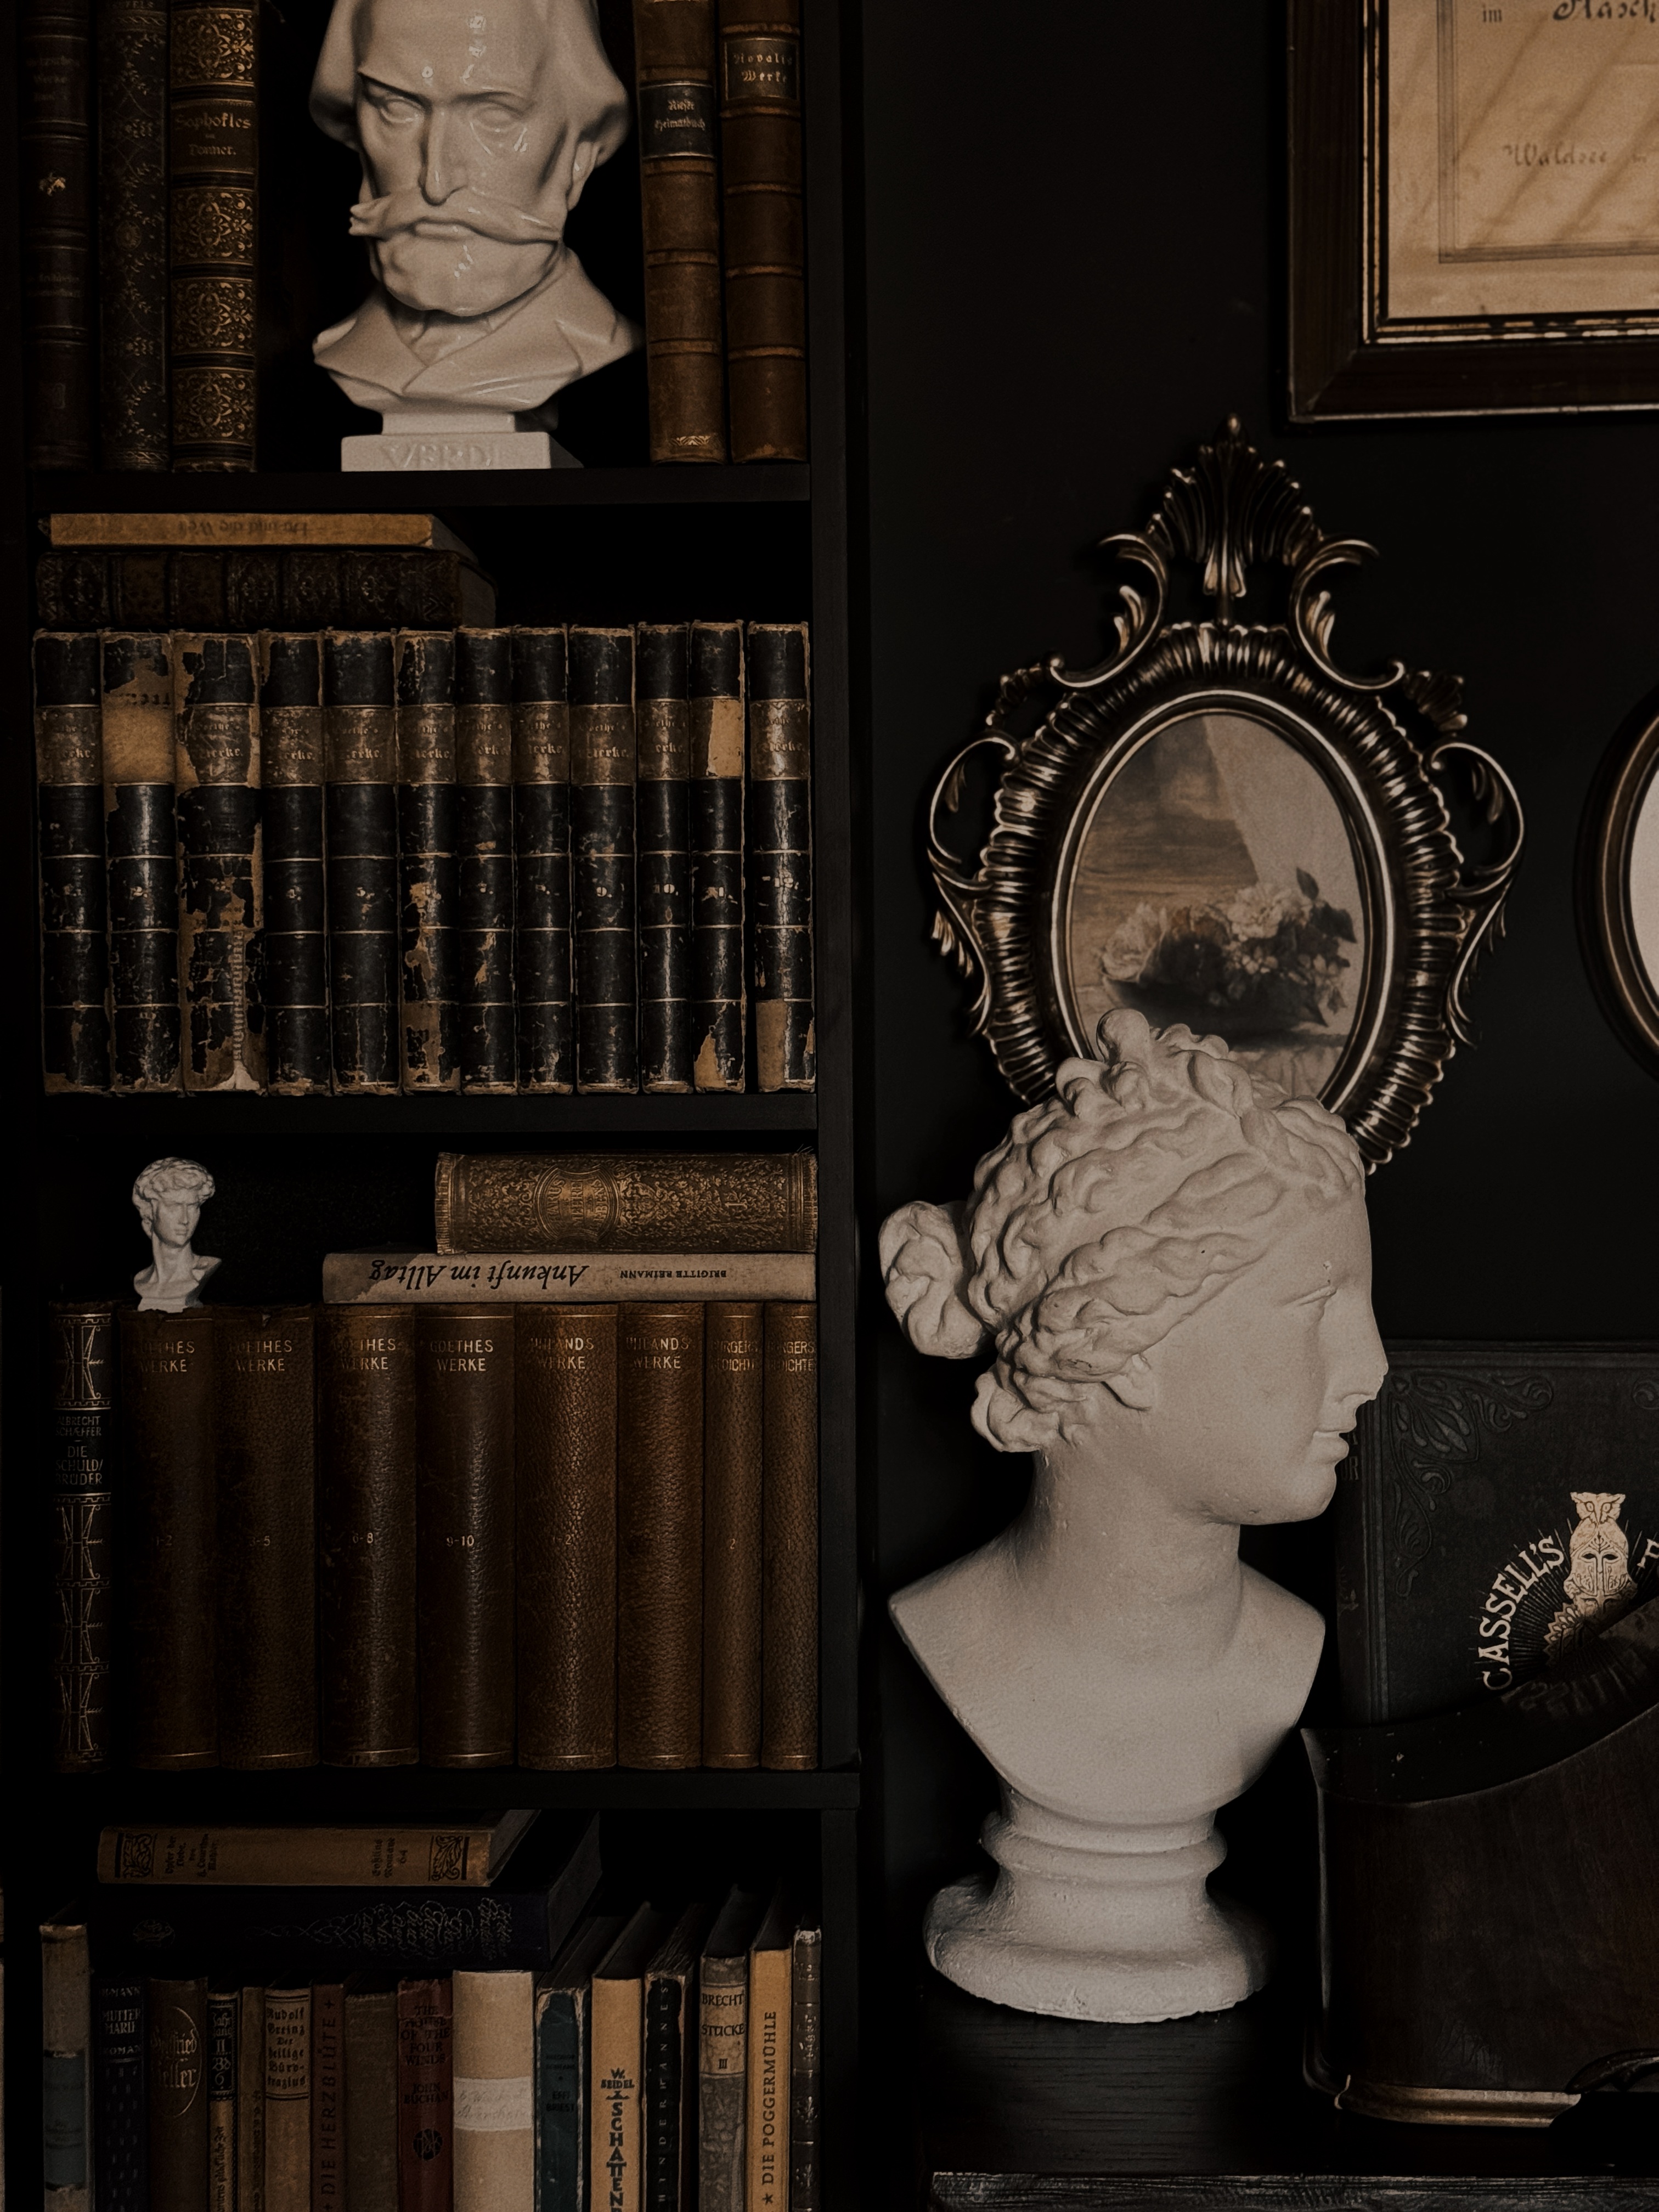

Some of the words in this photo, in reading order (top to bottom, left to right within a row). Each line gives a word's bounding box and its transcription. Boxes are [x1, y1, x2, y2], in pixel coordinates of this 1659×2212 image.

[382, 443, 501, 469] VERDI
[368, 1260, 445, 1289] Alltag
[450, 1265, 481, 1287] im
[487, 1260, 590, 1289] Ankunft
[619, 1269, 672, 1280] REIMANN
[676, 1269, 727, 1279] BRIGITTE
[136, 1340, 196, 1355] OETHES
[430, 1338, 494, 1353] GOETHES
[139, 1358, 188, 1373] WERKE
[235, 1358, 286, 1372] WERKE
[341, 1356, 389, 1370] WERKE
[437, 1357, 487, 1372] WERKE
[537, 1355, 586, 1370] WERKE
[633, 1355, 682, 1370] WERKE
[67, 1445, 88, 1459] DIE
[446, 1534, 475, 1547] 9-10
[1477, 1536, 1565, 1691] CASSELL'S
[702, 1993, 744, 2007] BRECHT
[400, 2029, 418, 2041] OF
[719, 2058, 728, 2069] III
[610, 2067, 625, 2080] W.
[762, 2011, 776, 2144] POGGERMÜHLE
[317, 2017, 336, 2150] HERZBLÜTE
[601, 2079, 635, 2089] SEIDEL
[762, 2155, 774, 2185] DIE
[321, 2160, 336, 2196] DIE
